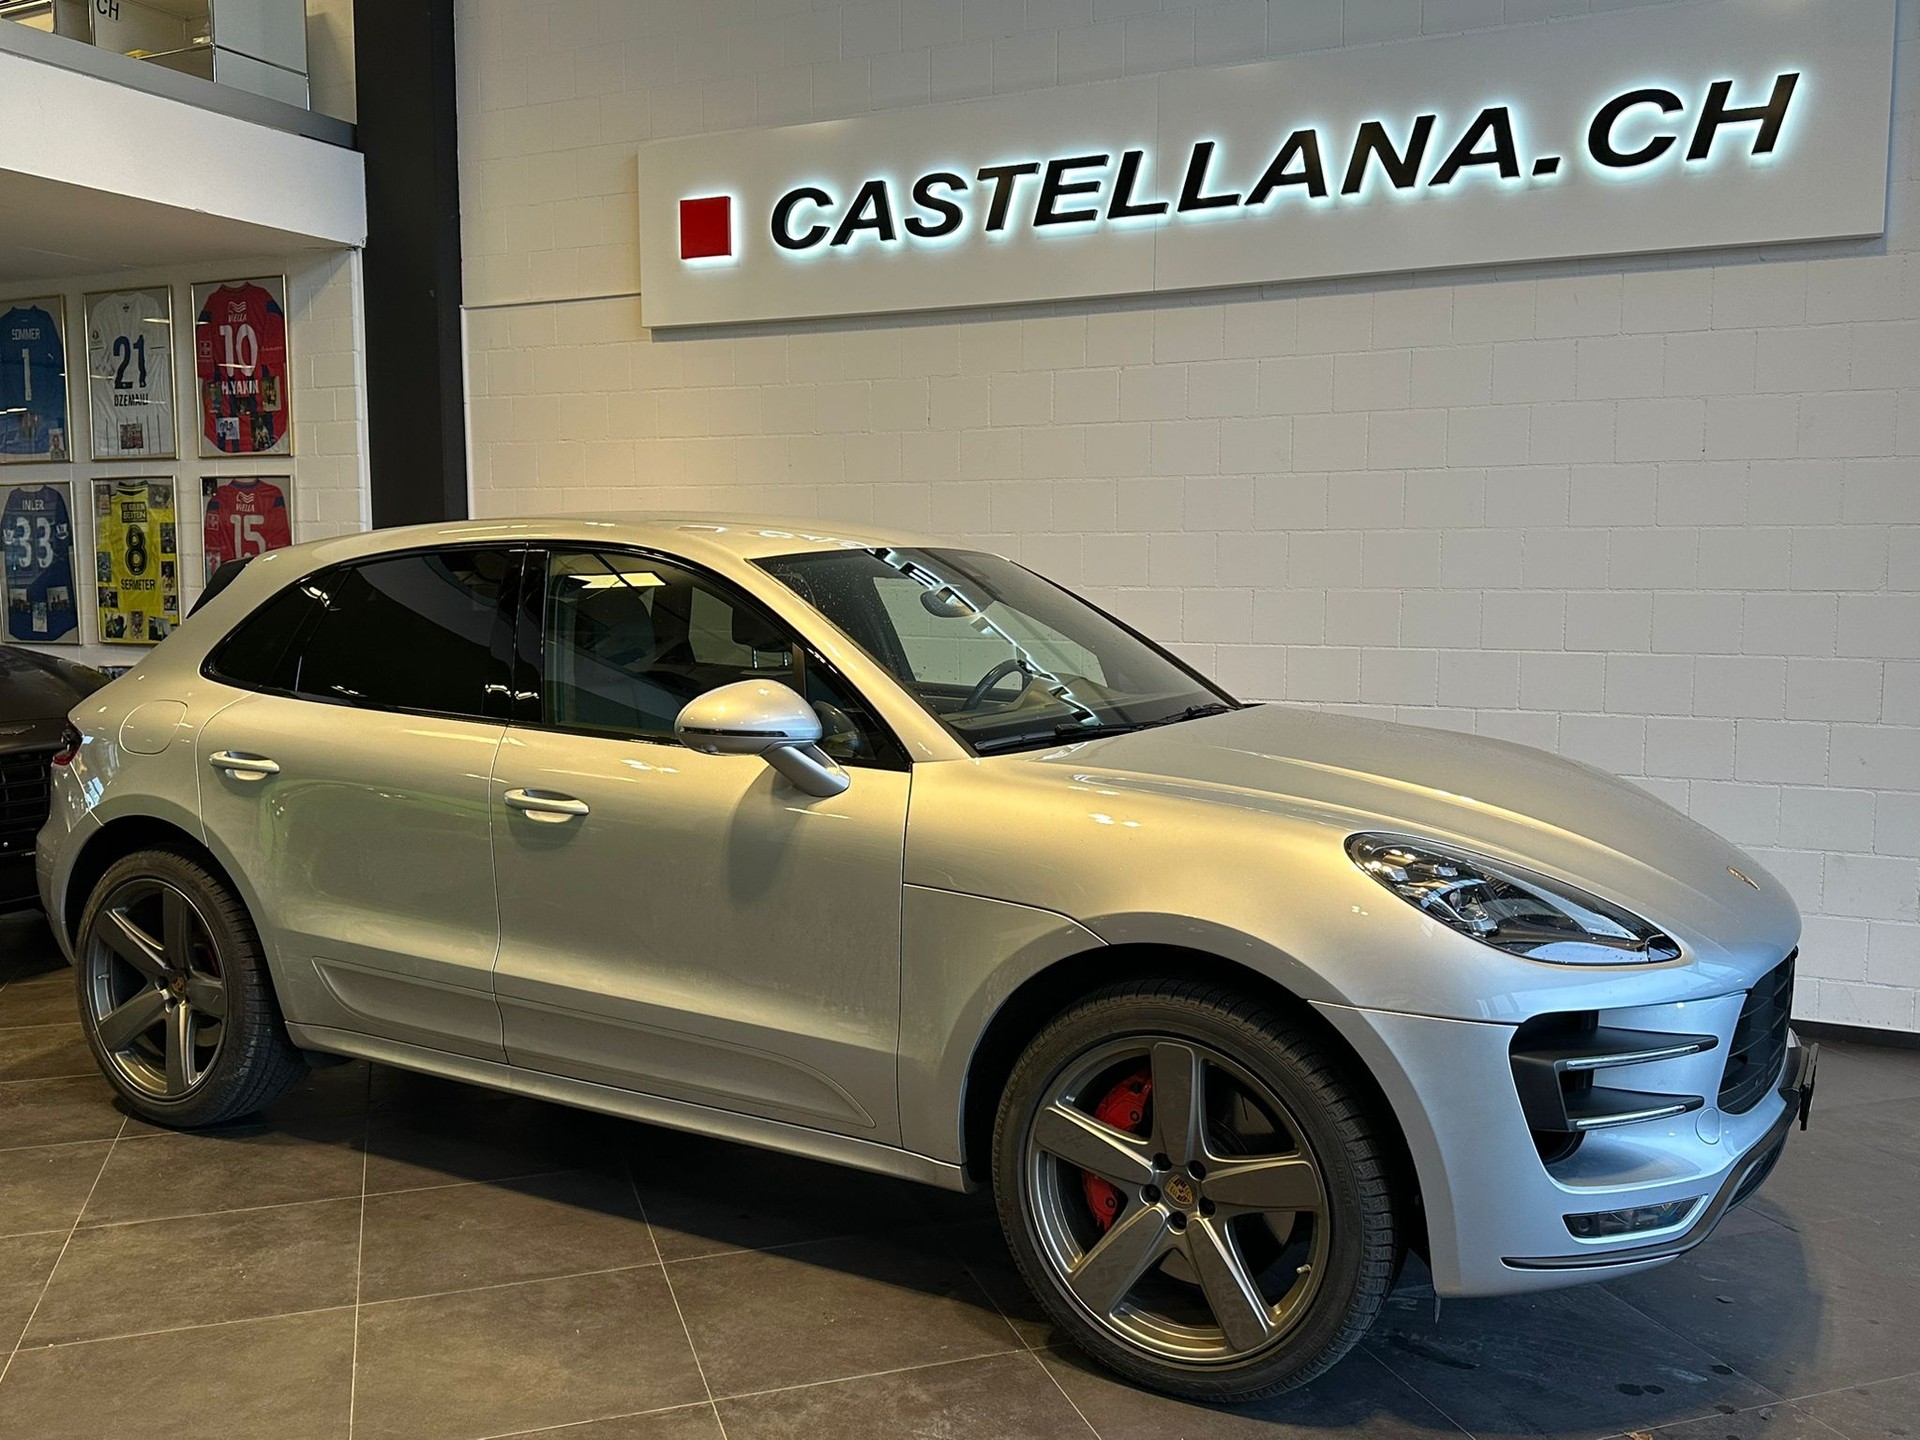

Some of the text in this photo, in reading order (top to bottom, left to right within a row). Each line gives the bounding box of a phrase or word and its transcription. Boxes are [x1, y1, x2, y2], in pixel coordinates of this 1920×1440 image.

[97, 0, 119, 20] CH
[769, 71, 1801, 250] CASTELLANA.CH
[11, 328, 40, 340] SOMMER
[219, 323, 258, 377] 10
[22, 348, 32, 401] 1
[113, 334, 147, 389] 21
[221, 379, 260, 395] H.YAKIN
[22, 499, 45, 511] INLER
[16, 516, 54, 569] 33
[125, 524, 148, 576] 8
[229, 514, 266, 559] 15
[120, 579, 156, 591] SERMETER
